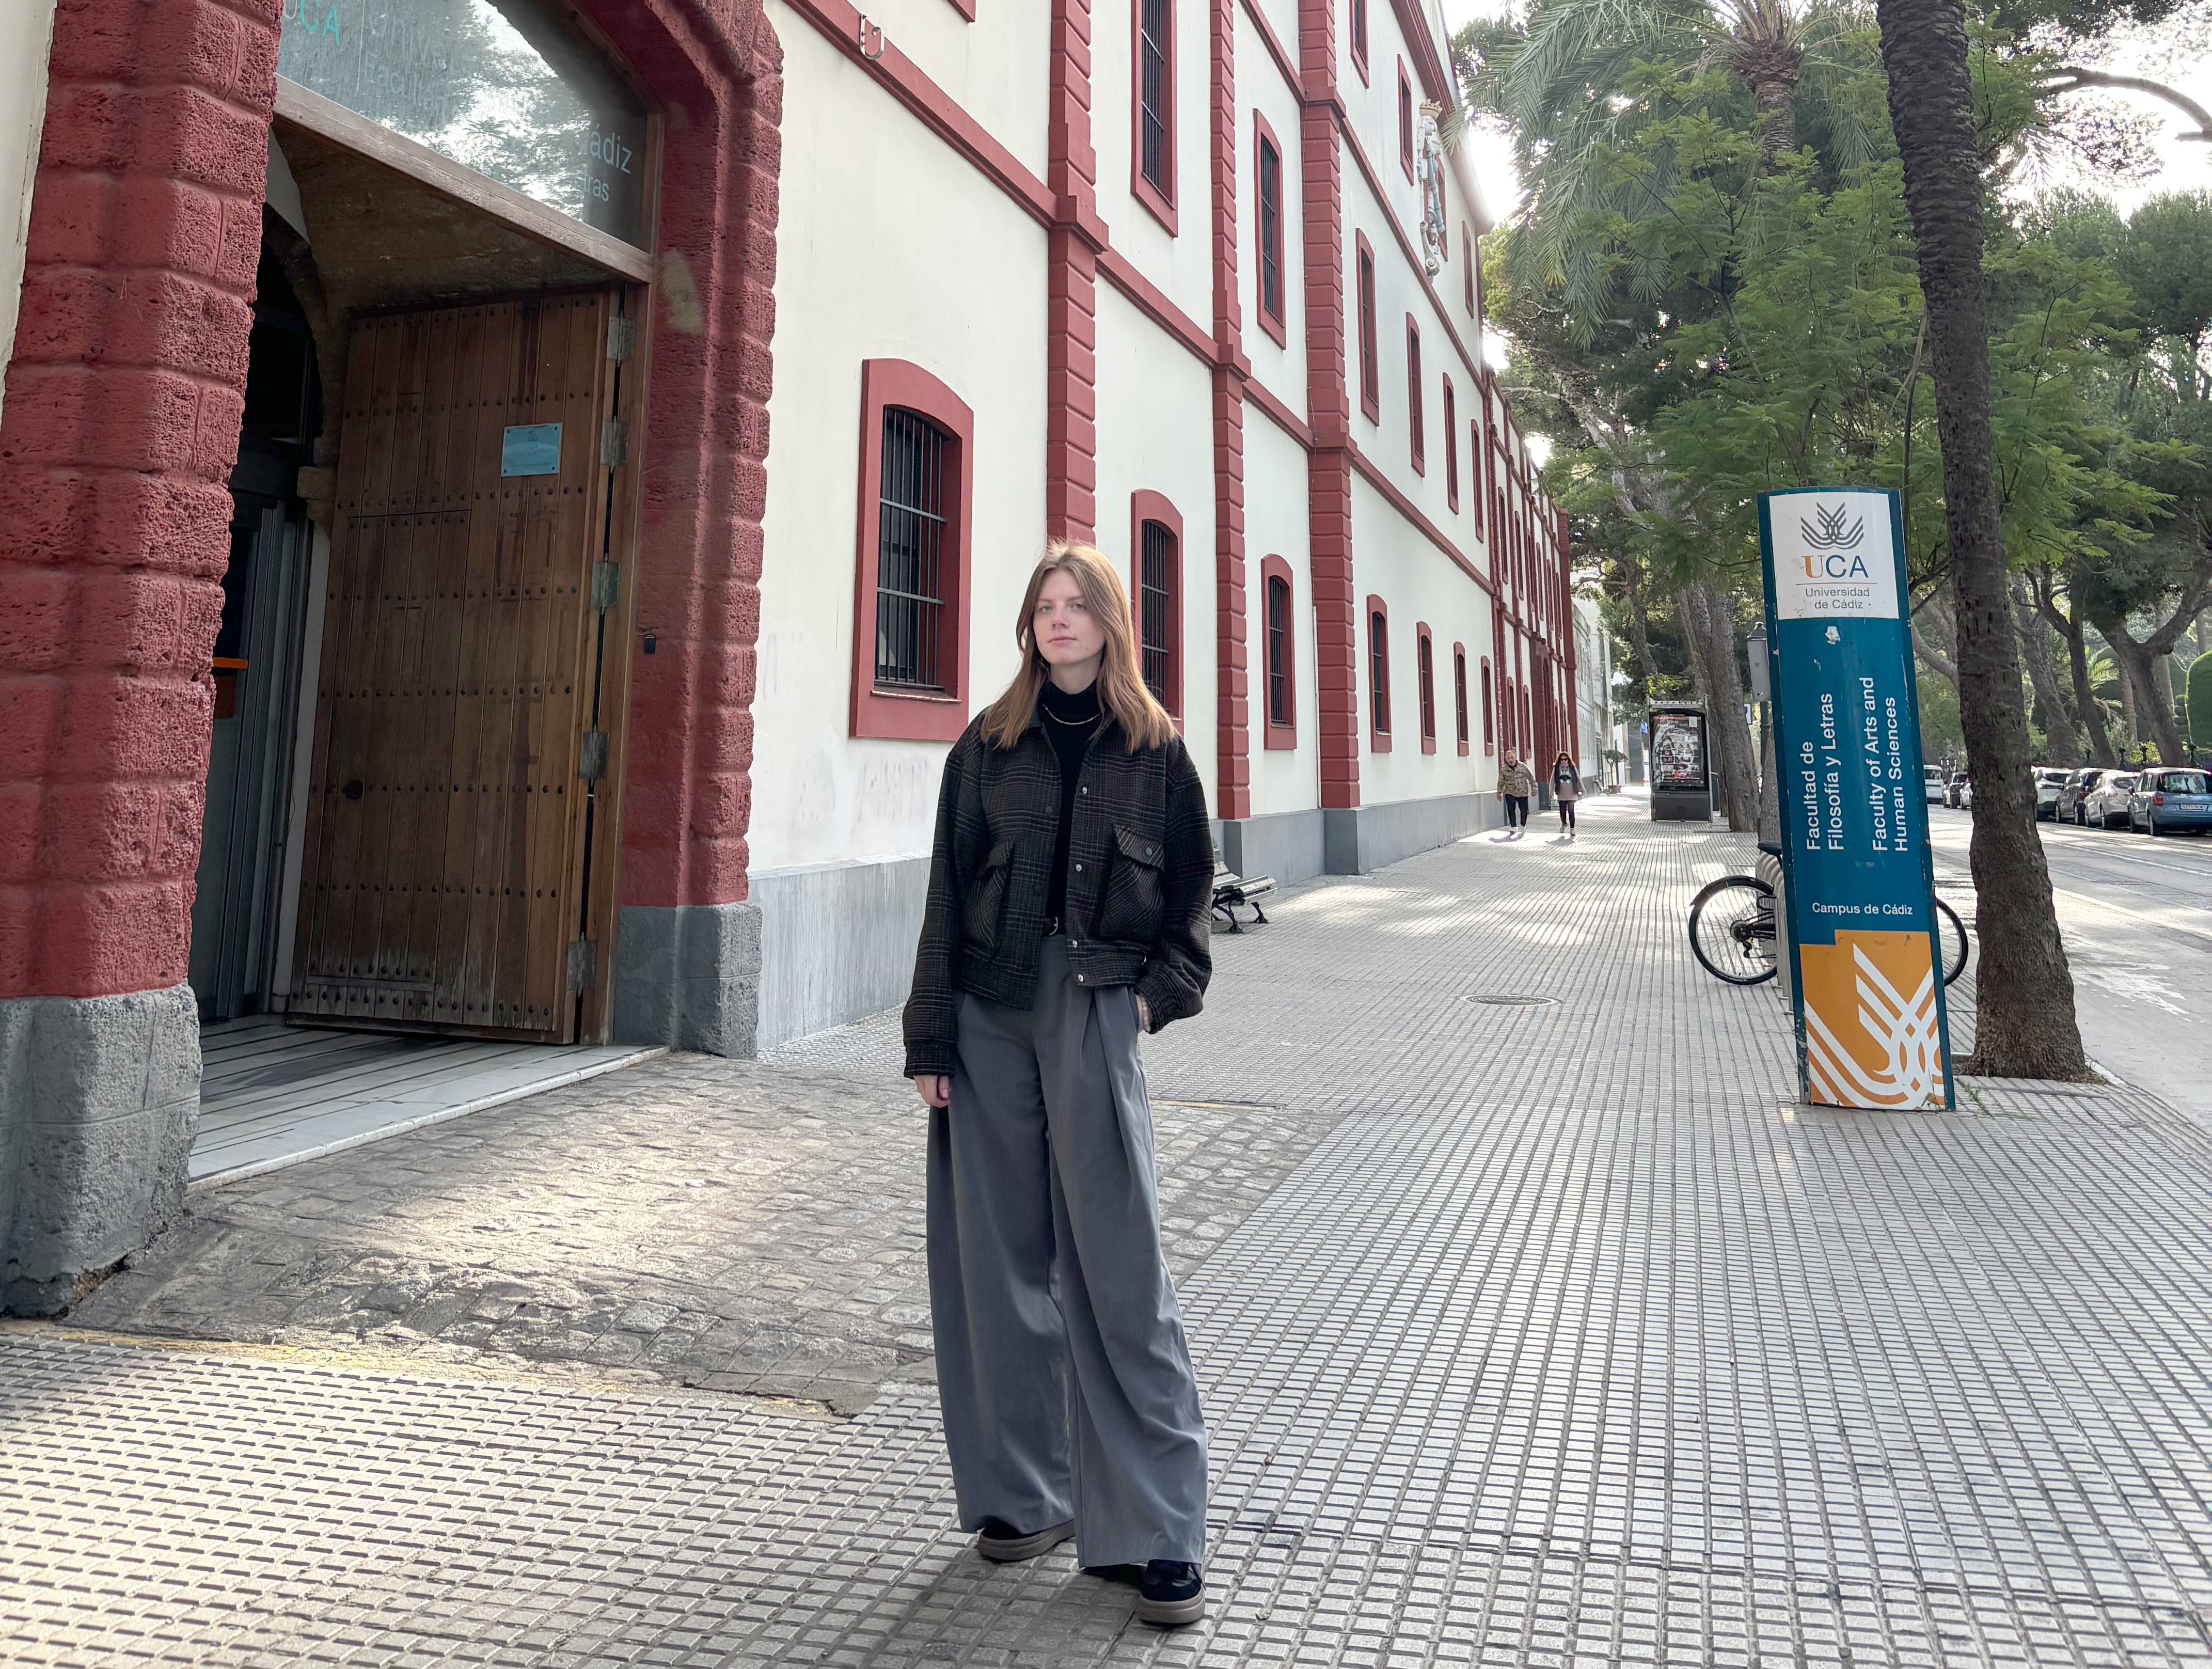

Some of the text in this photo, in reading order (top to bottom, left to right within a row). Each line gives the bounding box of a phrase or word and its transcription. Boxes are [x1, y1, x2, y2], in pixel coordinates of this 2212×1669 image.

[590, 123, 632, 175] ádiz
[584, 169, 610, 201] tras
[1802, 555, 1869, 578] UCA
[1805, 587, 1870, 597] Universidad
[1814, 599, 1863, 609] de Cádiz
[1820, 694, 1844, 850] Filosofía y Letras
[1859, 677, 1888, 851] Faculty of Arts and
[1885, 697, 1908, 852] Human Sciences
[1799, 742, 1821, 850] Facultad de
[1812, 902, 1914, 916] Campus de Cádiz
